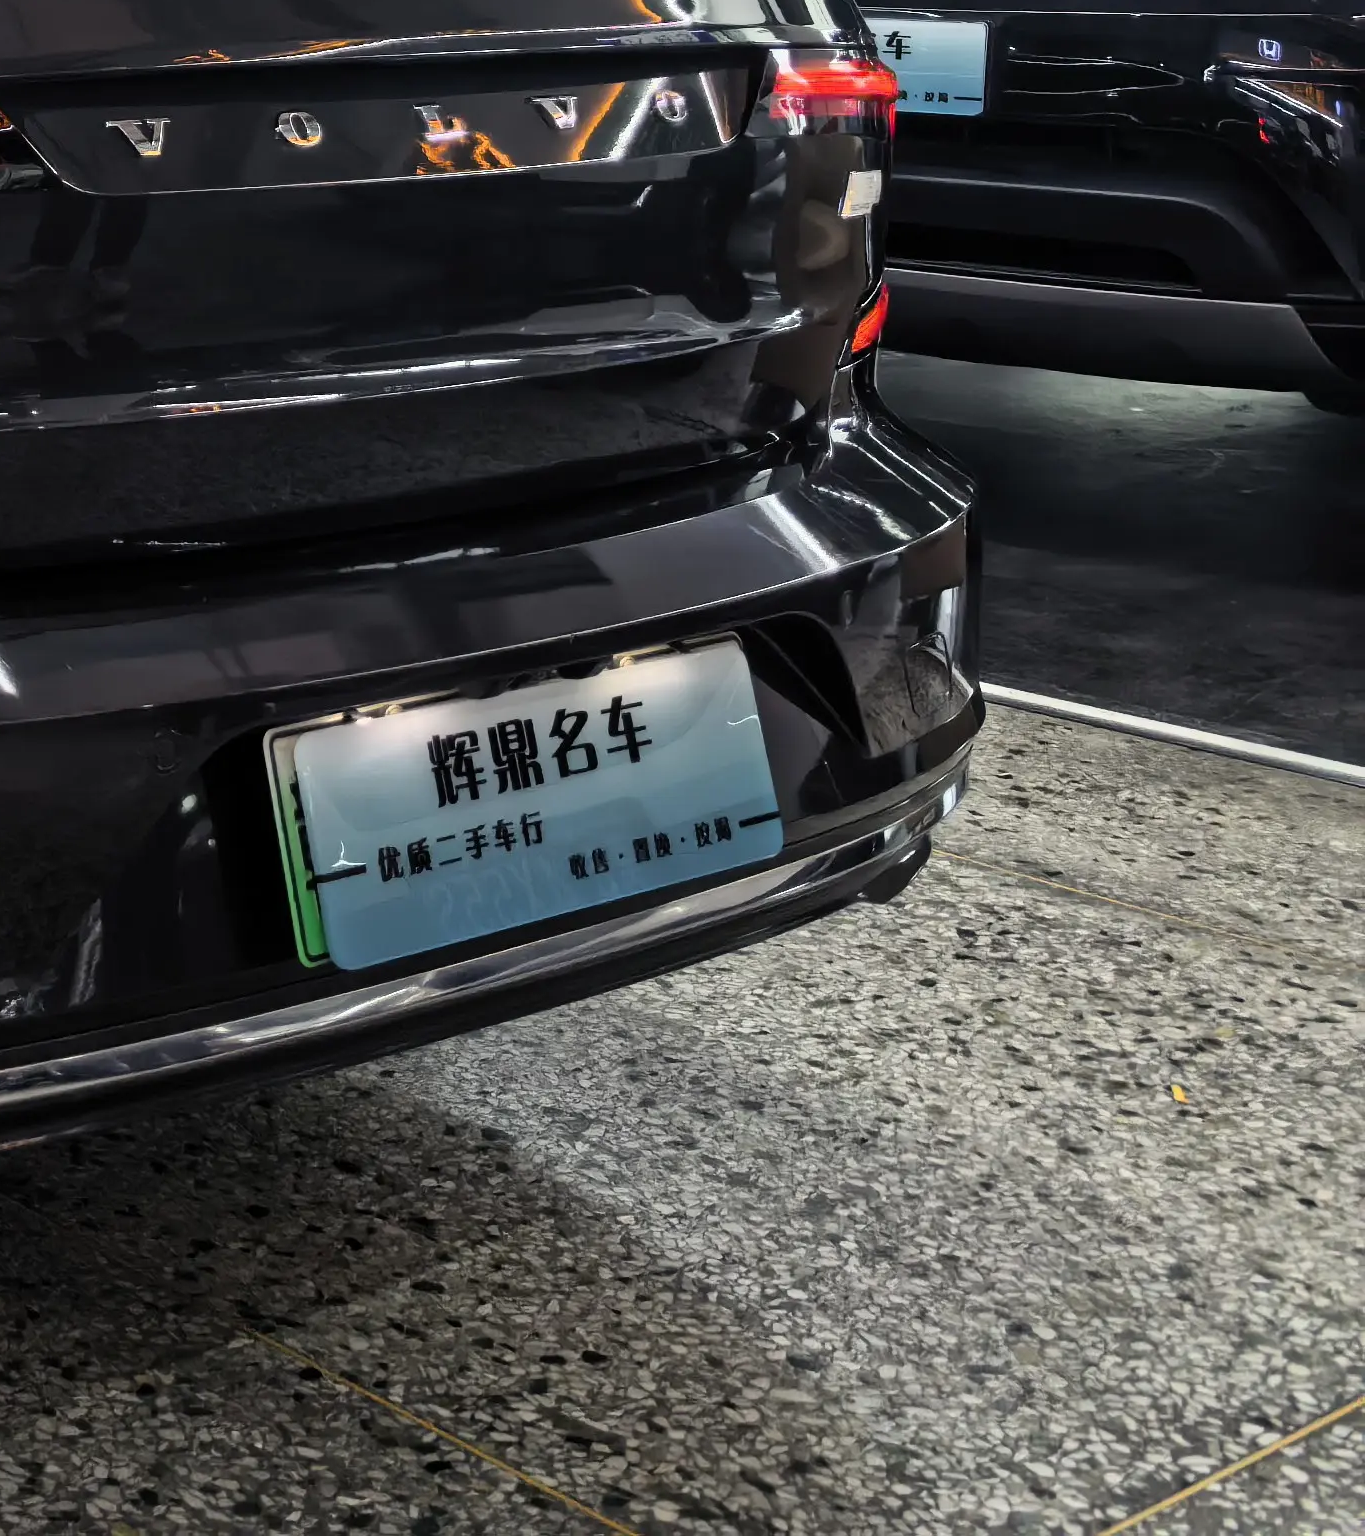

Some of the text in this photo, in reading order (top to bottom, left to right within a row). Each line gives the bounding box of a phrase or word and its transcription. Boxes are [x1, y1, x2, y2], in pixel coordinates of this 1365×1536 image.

[105, 89, 688, 157] VOLVO
[427, 695, 654, 808] 辉鼎名车
[377, 811, 544, 882] 优质二手车行
